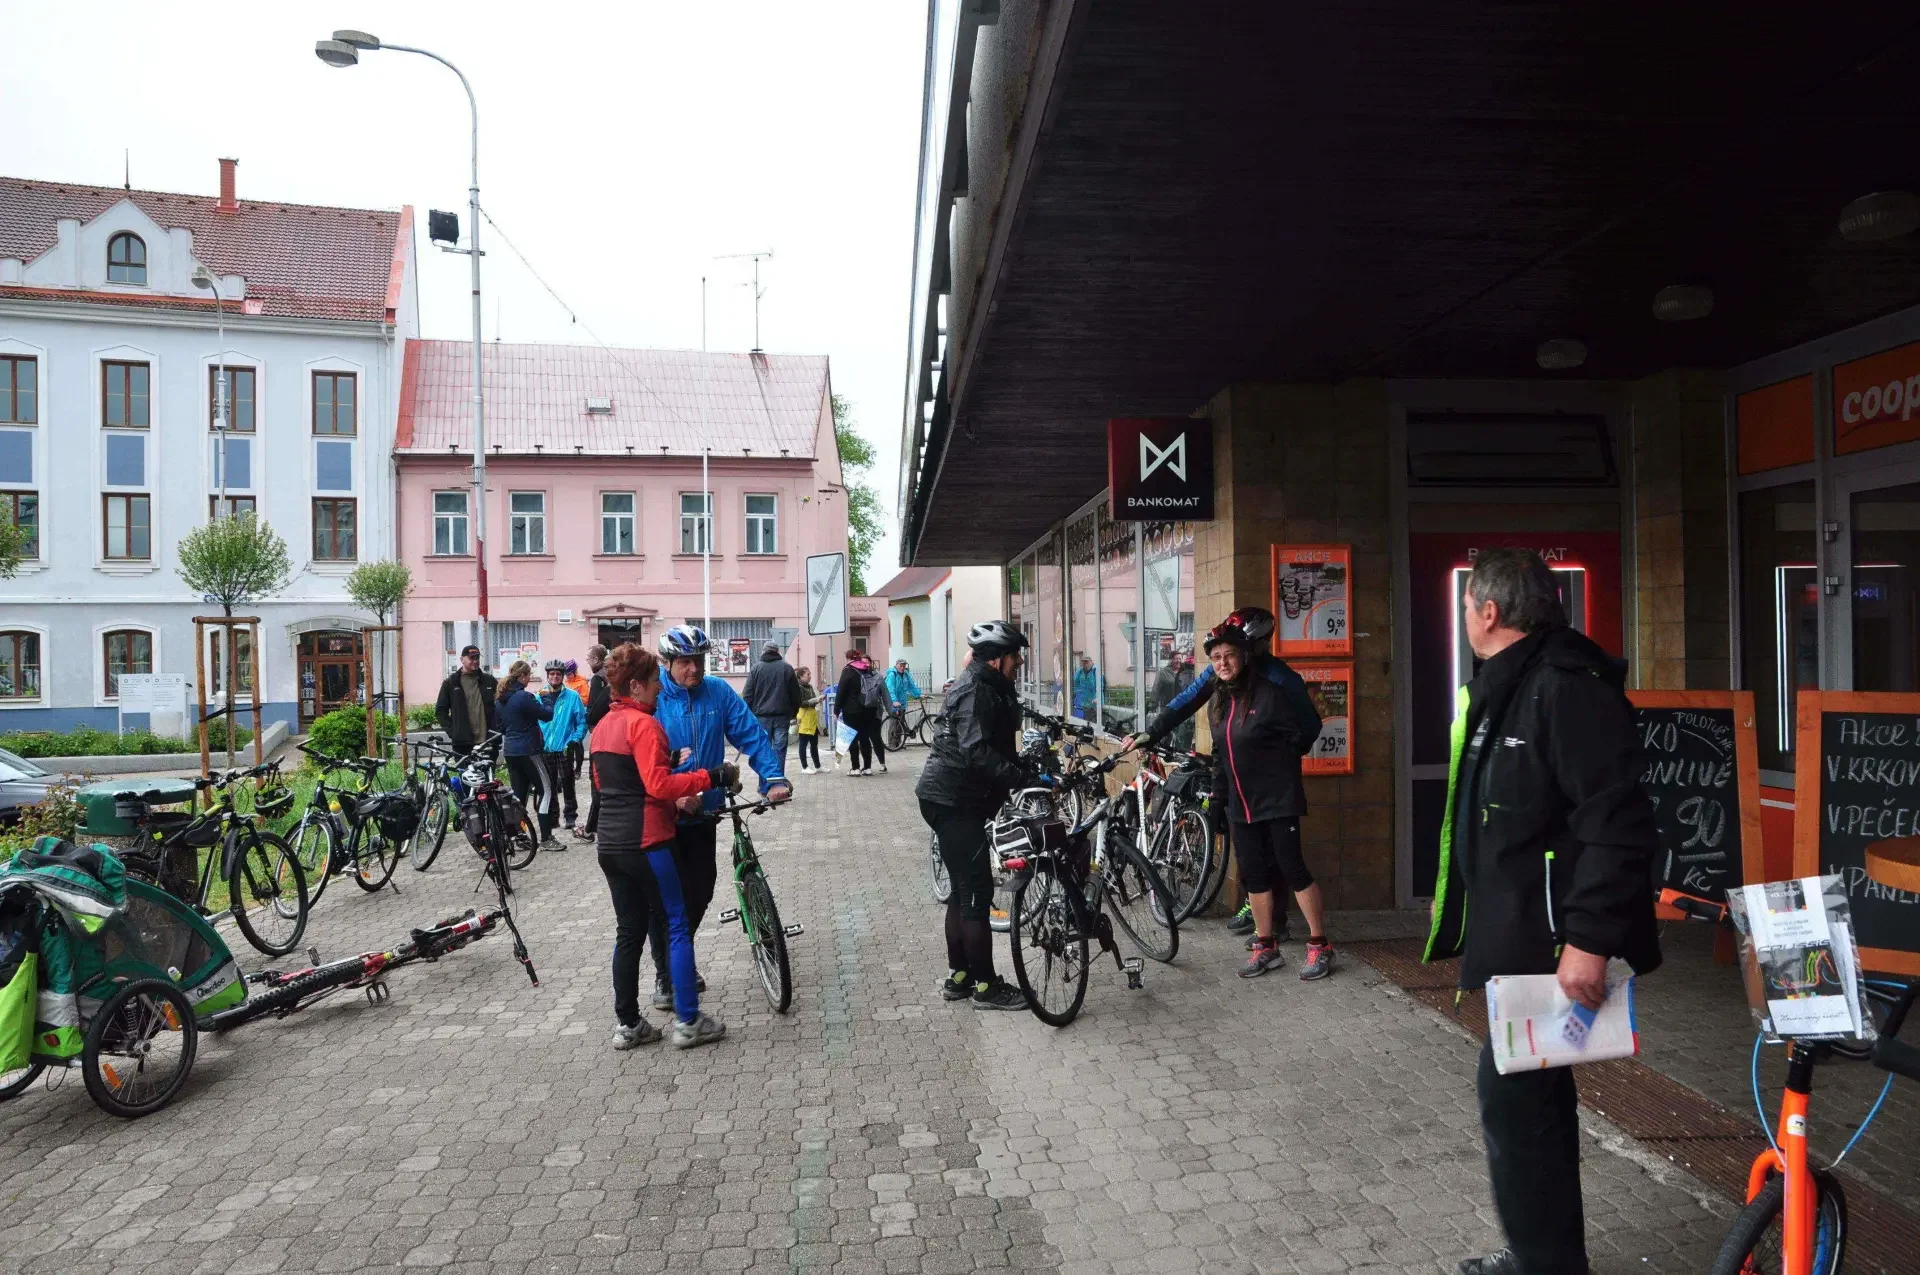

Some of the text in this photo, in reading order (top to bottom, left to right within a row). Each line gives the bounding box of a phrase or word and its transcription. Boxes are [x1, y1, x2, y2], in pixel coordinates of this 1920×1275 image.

[1127, 497, 1200, 507] BANKOMAT
[1295, 551, 1332, 561] AKCE
[1467, 547, 1568, 561] BMAT
